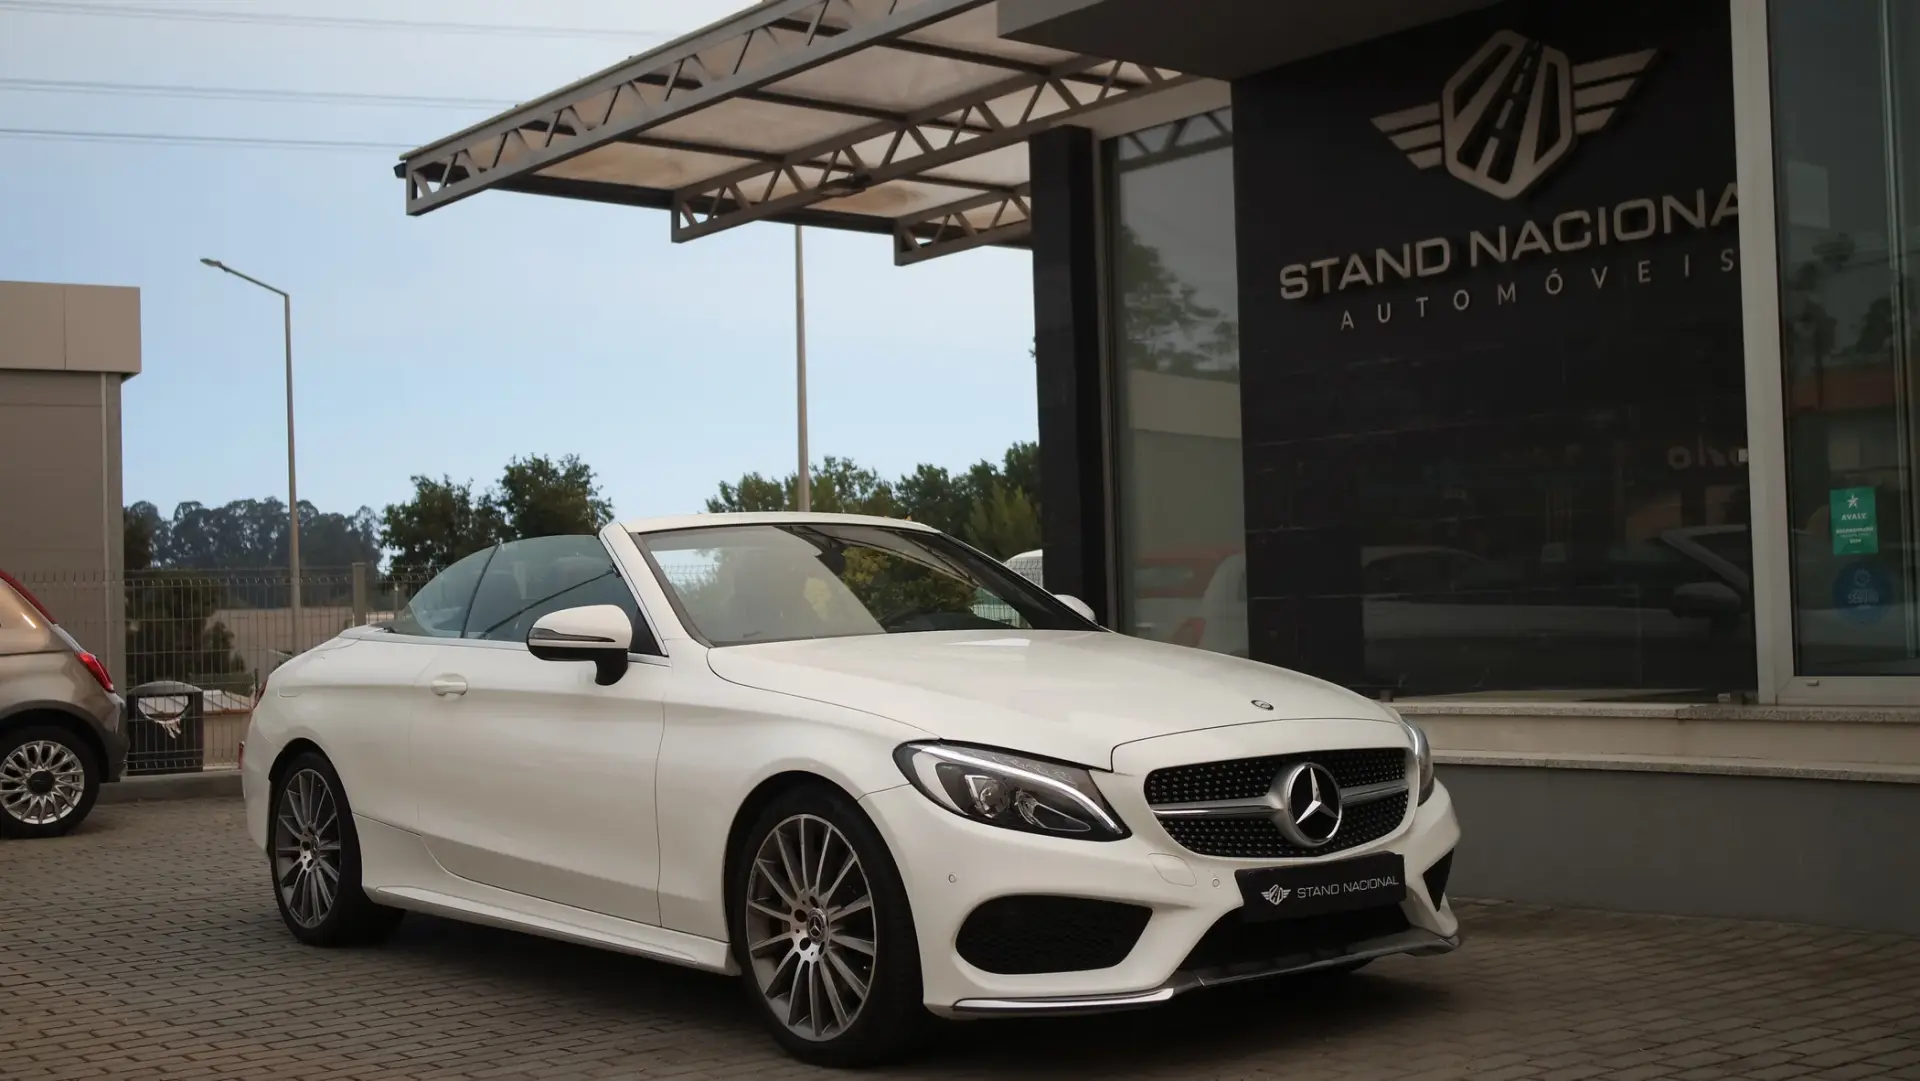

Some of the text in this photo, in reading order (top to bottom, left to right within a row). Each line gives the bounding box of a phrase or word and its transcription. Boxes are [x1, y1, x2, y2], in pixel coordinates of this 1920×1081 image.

[1279, 237, 1450, 300] STAND
[1340, 249, 1735, 331] AUTOMÓVEIS
[1297, 876, 1399, 899] STAND NACIONAL
